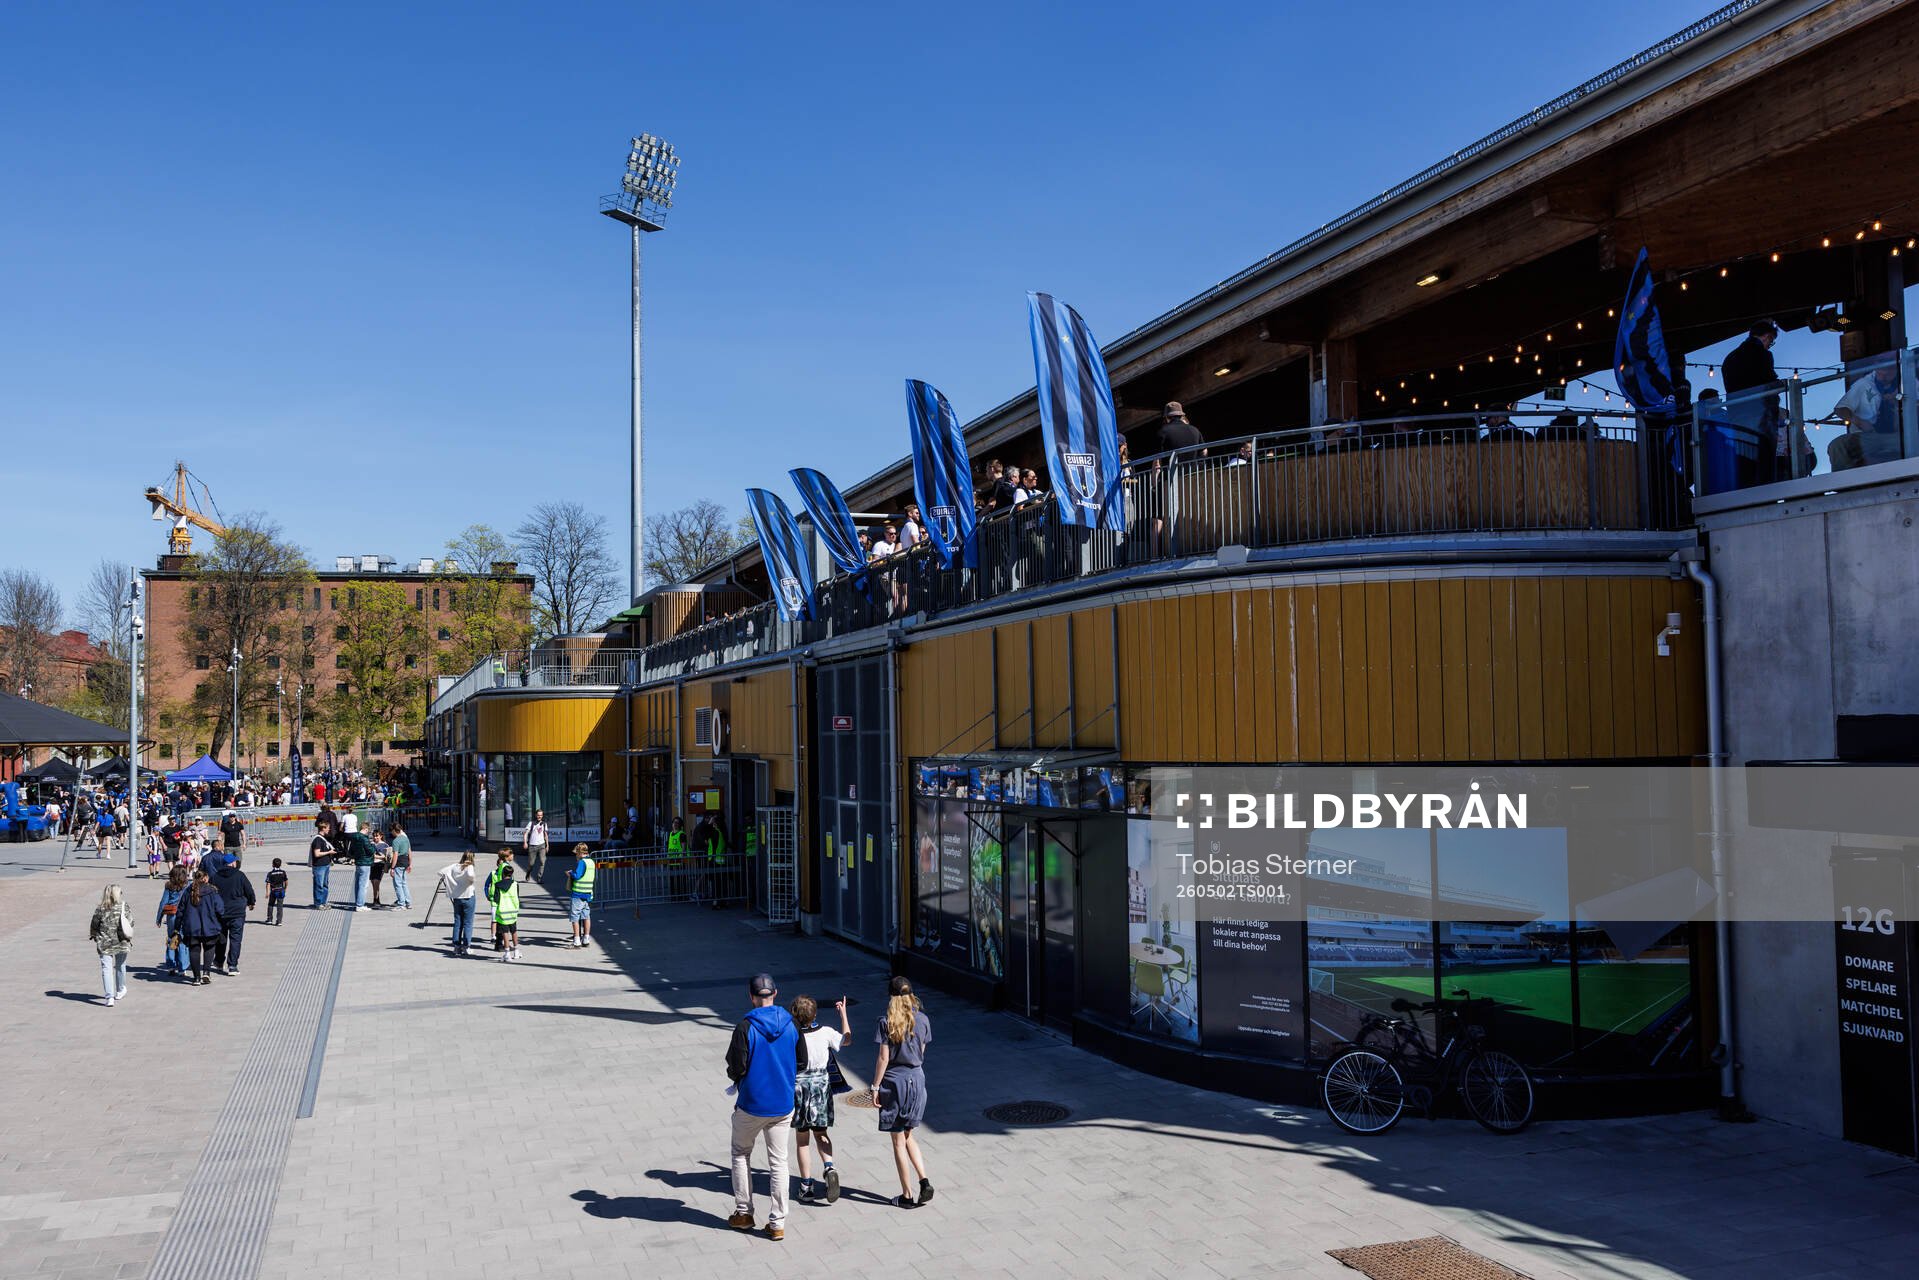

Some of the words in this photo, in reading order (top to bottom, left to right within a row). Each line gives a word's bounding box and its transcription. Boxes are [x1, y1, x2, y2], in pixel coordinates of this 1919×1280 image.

[1246, 919, 1269, 929] lediga
[1841, 905, 1896, 936] 12G
[1213, 927, 1237, 937] lokaler
[1239, 930, 1249, 938] att
[1251, 932, 1281, 941] anpassa
[1213, 939, 1223, 947] till
[1224, 940, 1240, 949] dina
[1241, 942, 1267, 951] behov!
[1845, 955, 1895, 973] DOMARE
[1846, 977, 1897, 996] SPELARE
[1840, 998, 1904, 1020] MATCHDEL
